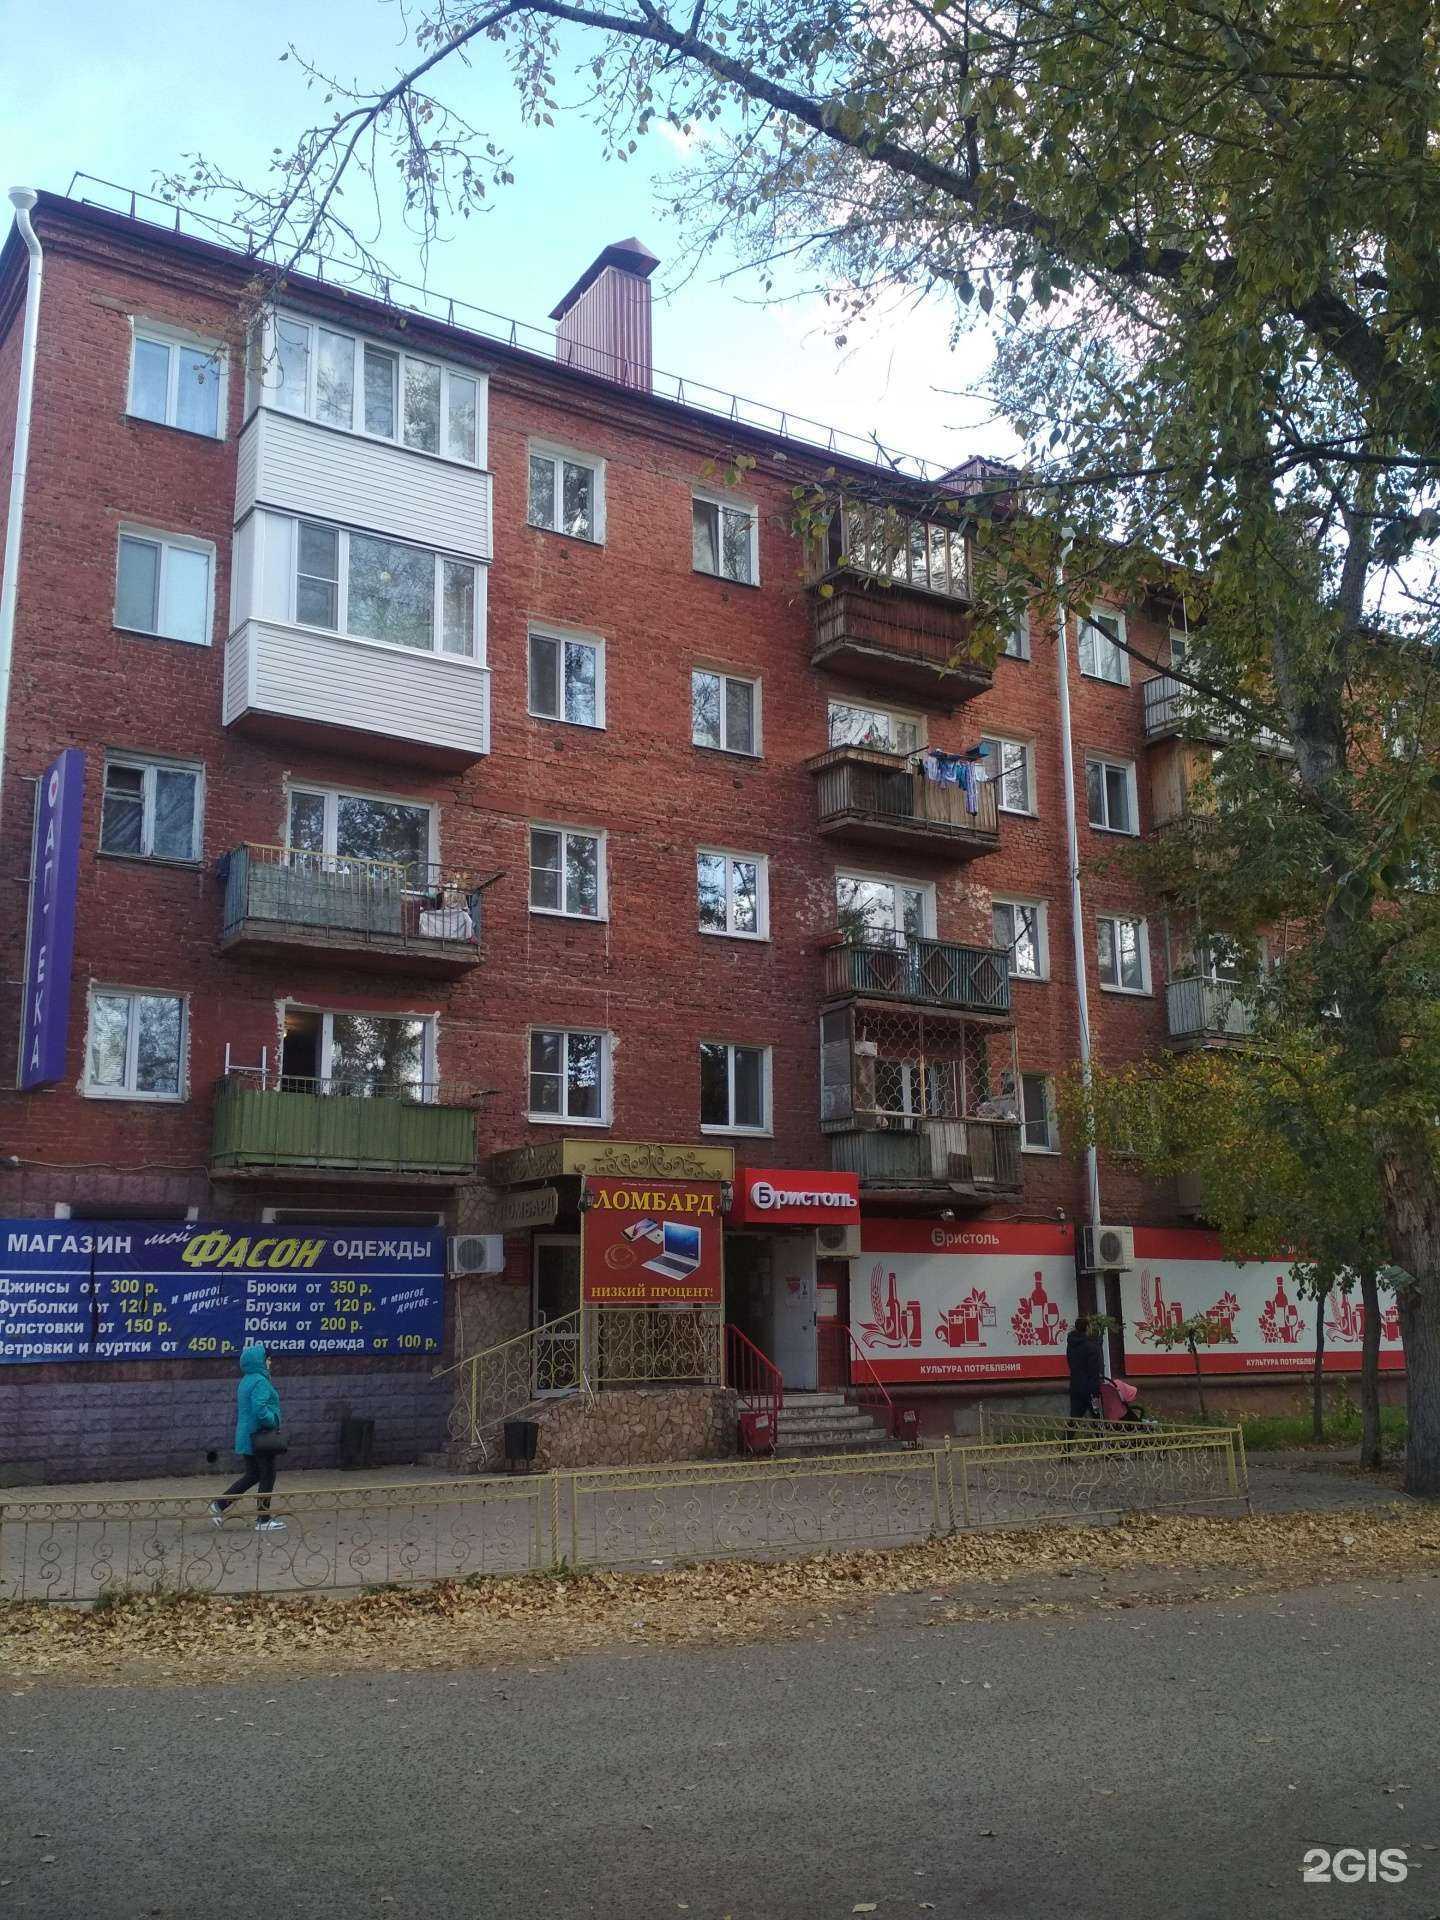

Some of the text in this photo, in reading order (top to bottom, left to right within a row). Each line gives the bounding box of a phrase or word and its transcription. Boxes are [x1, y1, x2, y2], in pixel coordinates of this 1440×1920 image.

[593, 1190, 715, 1216] ЛОМБАРД
[751, 1182, 858, 1209] Бристоль
[931, 1228, 1000, 1246] Бристоль
[8, 1224, 431, 1268] МАГАЗИН мой ФАСОН ОДЕЖДЫ
[0, 1279, 158, 1296] Джинсы от 300 р.
[247, 1280, 372, 1296] Брюки от 350 р.
[592, 1282, 713, 1300] НИЗКИЙ ПРОЦЕНТ!
[0, 1299, 78, 1317] Футболки
[120, 1298, 148, 1313] 120
[153, 1301, 167, 1316] р.
[246, 1298, 376, 1315] Блузки от 120 р.
[98, 1322, 115, 1333] от
[125, 1319, 153, 1333] 150
[158, 1321, 172, 1335] р.
[244, 1317, 363, 1333] Юбки от 200 р.
[79, 1342, 89, 1353] и
[96, 1342, 152, 1356] куртки
[161, 1341, 178, 1352] от
[188, 1337, 217, 1351] 450
[221, 1340, 235, 1353] р.
[309, 1338, 365, 1351] одежда
[373, 1338, 389, 1348] от
[397, 1335, 421, 1348] 100
[425, 1338, 437, 1350] р.
[920, 1363, 1021, 1374] КУЛЬТУРА ПОТРЕБЛЕНИЯ
[1246, 1359, 1279, 1367] КУЛЬТУРА
